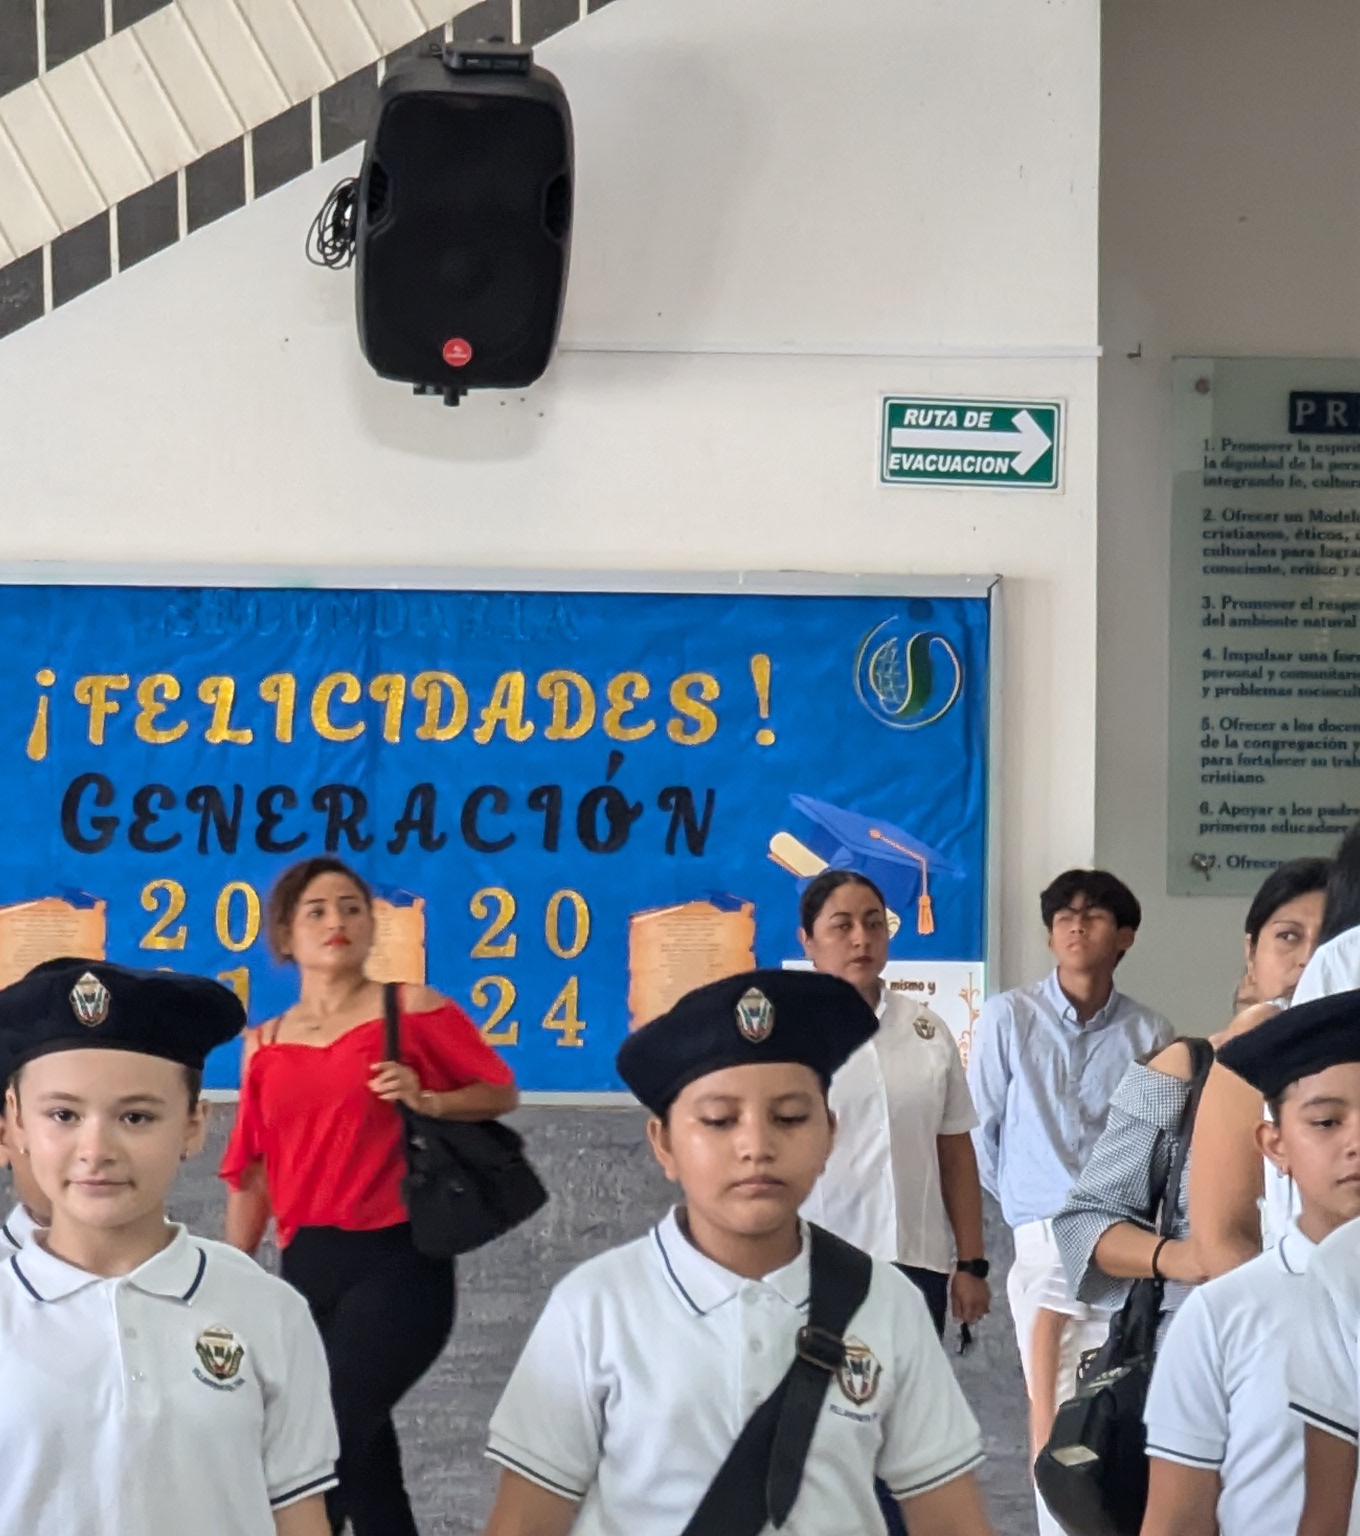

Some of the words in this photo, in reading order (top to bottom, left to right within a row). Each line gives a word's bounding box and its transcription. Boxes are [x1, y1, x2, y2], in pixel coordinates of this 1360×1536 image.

[903, 408, 957, 427] RUTA
[963, 410, 992, 428] DE
[1298, 440, 1311, 455] la
[889, 452, 1010, 474] EVACUACION
[60, 749, 717, 857] GENERACIÓN
[890, 980, 925, 992] mismo
[928, 981, 937, 995] y
